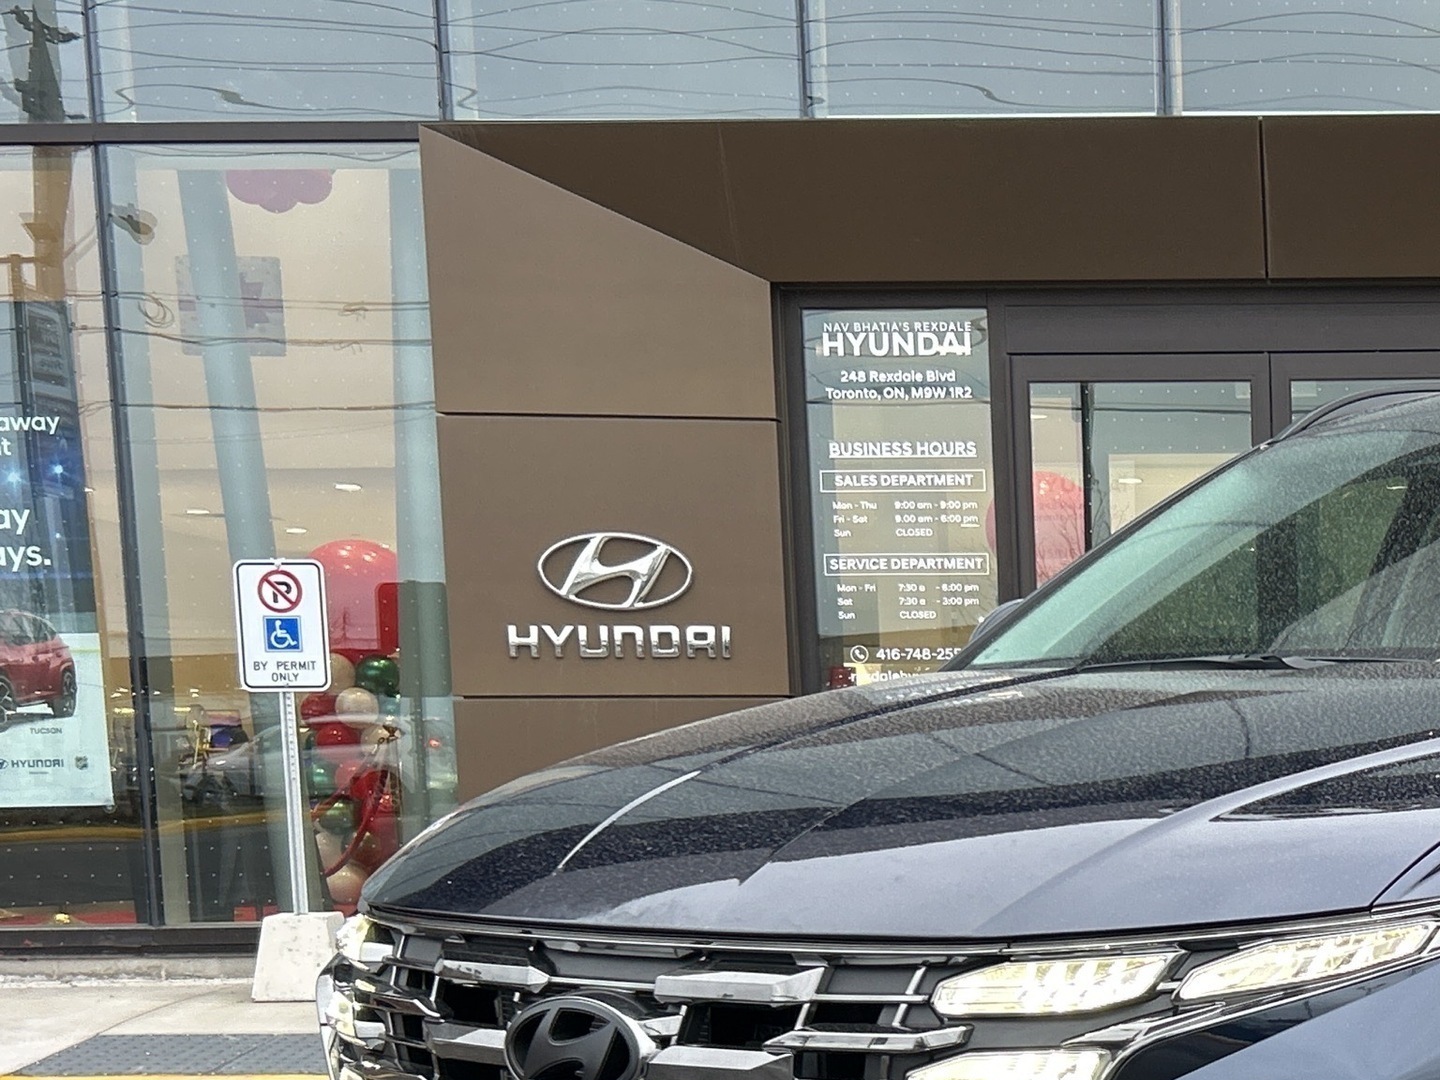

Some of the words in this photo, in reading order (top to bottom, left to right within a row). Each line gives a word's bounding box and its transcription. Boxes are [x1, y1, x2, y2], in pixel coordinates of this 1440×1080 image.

[823, 321, 849, 332] NAV
[853, 321, 910, 332] BHATIA'S
[914, 321, 972, 332] REXDALE
[822, 332, 972, 357] HYUNDAI
[840, 370, 866, 383] 248
[869, 370, 923, 382] Rexdale
[926, 370, 956, 382] Blvd
[825, 387, 882, 401] Toronto,
[883, 387, 909, 401] ON,
[911, 387, 947, 399] M9W
[949, 387, 973, 399] 1R2
[829, 442, 912, 457] BUSINESS
[916, 442, 977, 456] HOURS
[834, 474, 879, 487] SALES
[881, 474, 974, 486] DEPARTMENT
[832, 501, 853, 510] Mon
[860, 501, 878, 510] Thu
[917, 502, 933, 510] am
[962, 502, 978, 511] pm
[833, 515, 846, 524] Fri
[852, 515, 868, 524] Sat
[917, 516, 933, 524] am
[962, 515, 979, 525] pm
[833, 529, 852, 537] Sun
[895, 528, 934, 537] CLOSED
[829, 558, 888, 571] SERVICE
[891, 557, 984, 571] DEPARTMENT
[836, 583, 858, 593] Mon
[864, 583, 877, 592] Fri
[898, 583, 918, 592] 7:30
[964, 584, 980, 593] pm
[837, 597, 854, 606] Sat
[898, 597, 918, 606] 7:30
[942, 597, 963, 606] 3:00
[964, 598, 980, 607] pm
[838, 611, 856, 620] Sun
[899, 611, 937, 619] CLOSED
[507, 625, 731, 659] HYUNDAI
[253, 661, 268, 671] BY
[276, 660, 317, 671] PERMIT
[271, 672, 300, 682] ONLY
[30, 727, 63, 735] TUCSON
[11, 759, 65, 768] HYUNDAI
